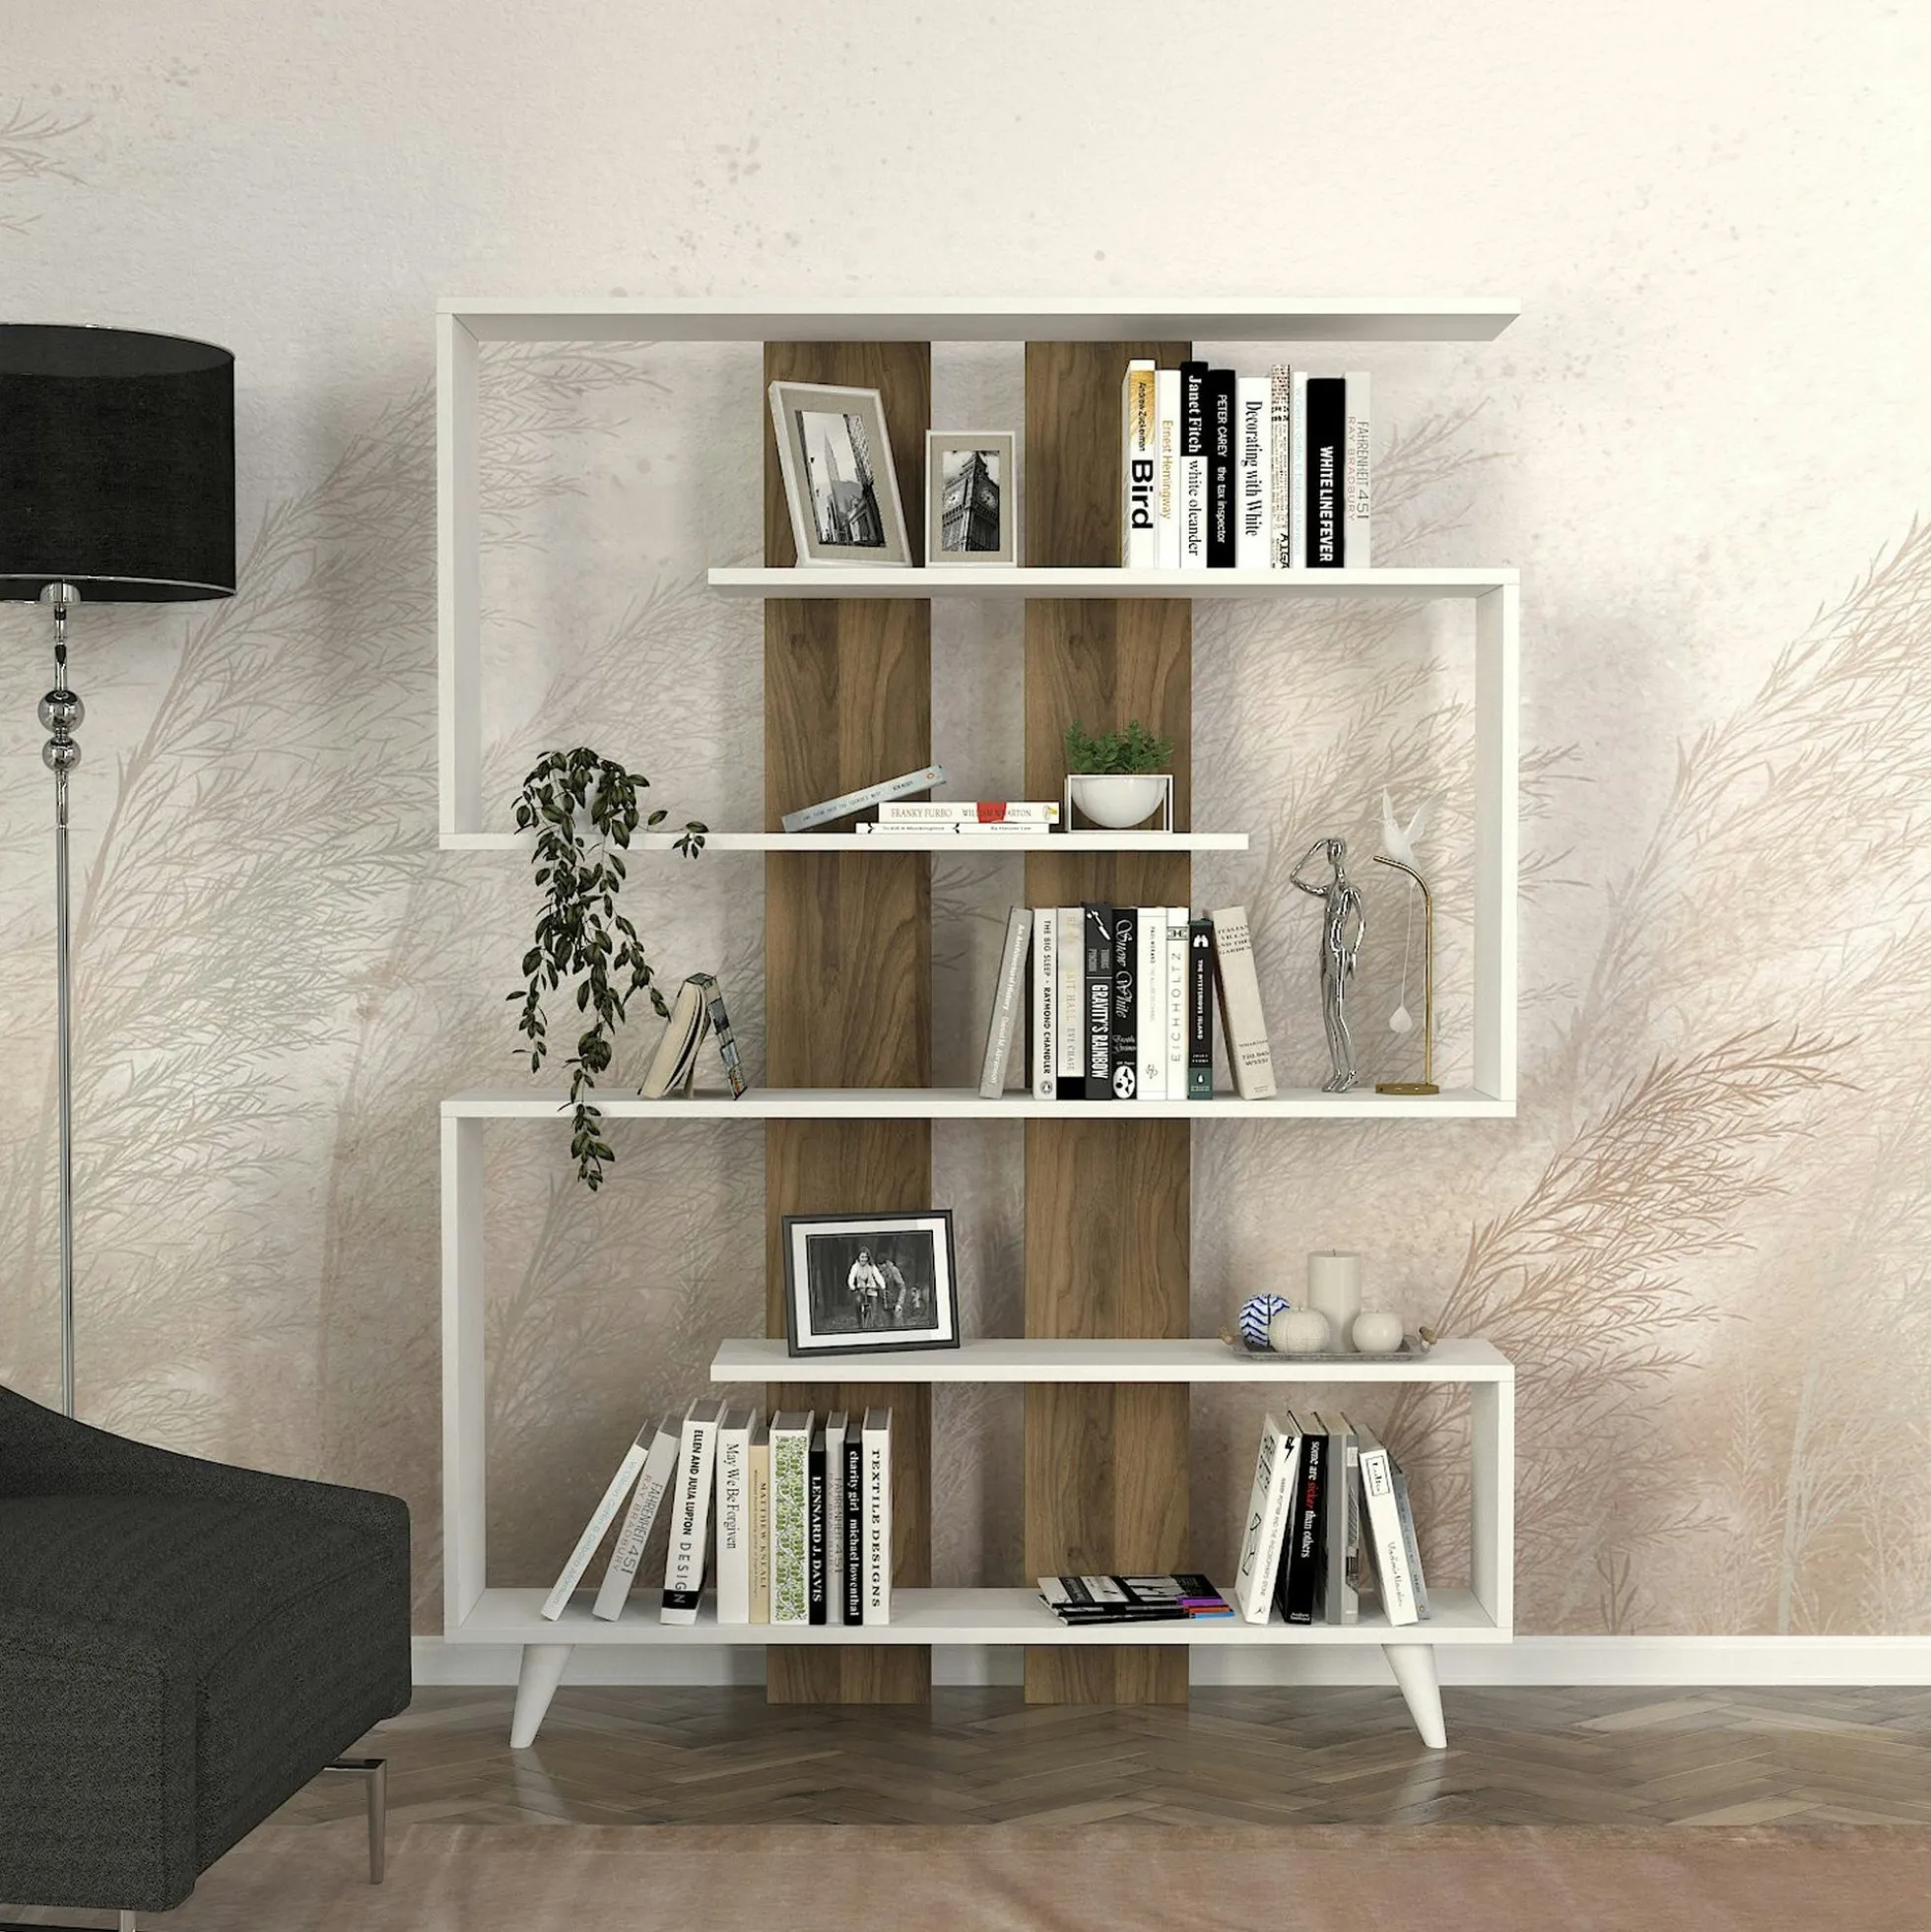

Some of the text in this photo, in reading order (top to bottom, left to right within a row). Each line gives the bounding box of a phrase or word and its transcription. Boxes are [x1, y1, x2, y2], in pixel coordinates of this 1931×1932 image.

[1132, 459, 1153, 529] Bird
[1160, 421, 1172, 519] Ernest Hemingway
[1188, 375, 1202, 556] Janet Fitch white oleander
[1216, 394, 1228, 543] PETER CAREY the tax inspector
[1241, 401, 1262, 536] Decorating with White
[1319, 446, 1333, 562] WHITE LINE FEVER
[1357, 422, 1368, 519] FAHRENHEIT 451
[891, 808, 922, 818] FRANKY
[1116, 919, 1133, 966] Snow
[1092, 984, 1108, 1078] GRAVITY'S RAINBOW
[1115, 970, 1132, 1019] White
[1170, 954, 1181, 1062] EICHHOLTZ
[723, 1443, 740, 1549] May We Be Forgiven
[1306, 1481, 1316, 1509] sicker
[1309, 1441, 1319, 1465] some
[612, 1473, 652, 1572] RAY BRADBURY
[622, 1482, 664, 1574] FAHRENHEIT 451
[673, 1430, 703, 1604] ELLEN AND JULIA LUPTON DESIGN
[812, 1476, 822, 1602] LENNARD J. DAVIS
[847, 1450, 860, 1616] charity girl michael lowenthal
[1300, 1531, 1312, 1559] others
[1303, 1510, 1315, 1530] than
